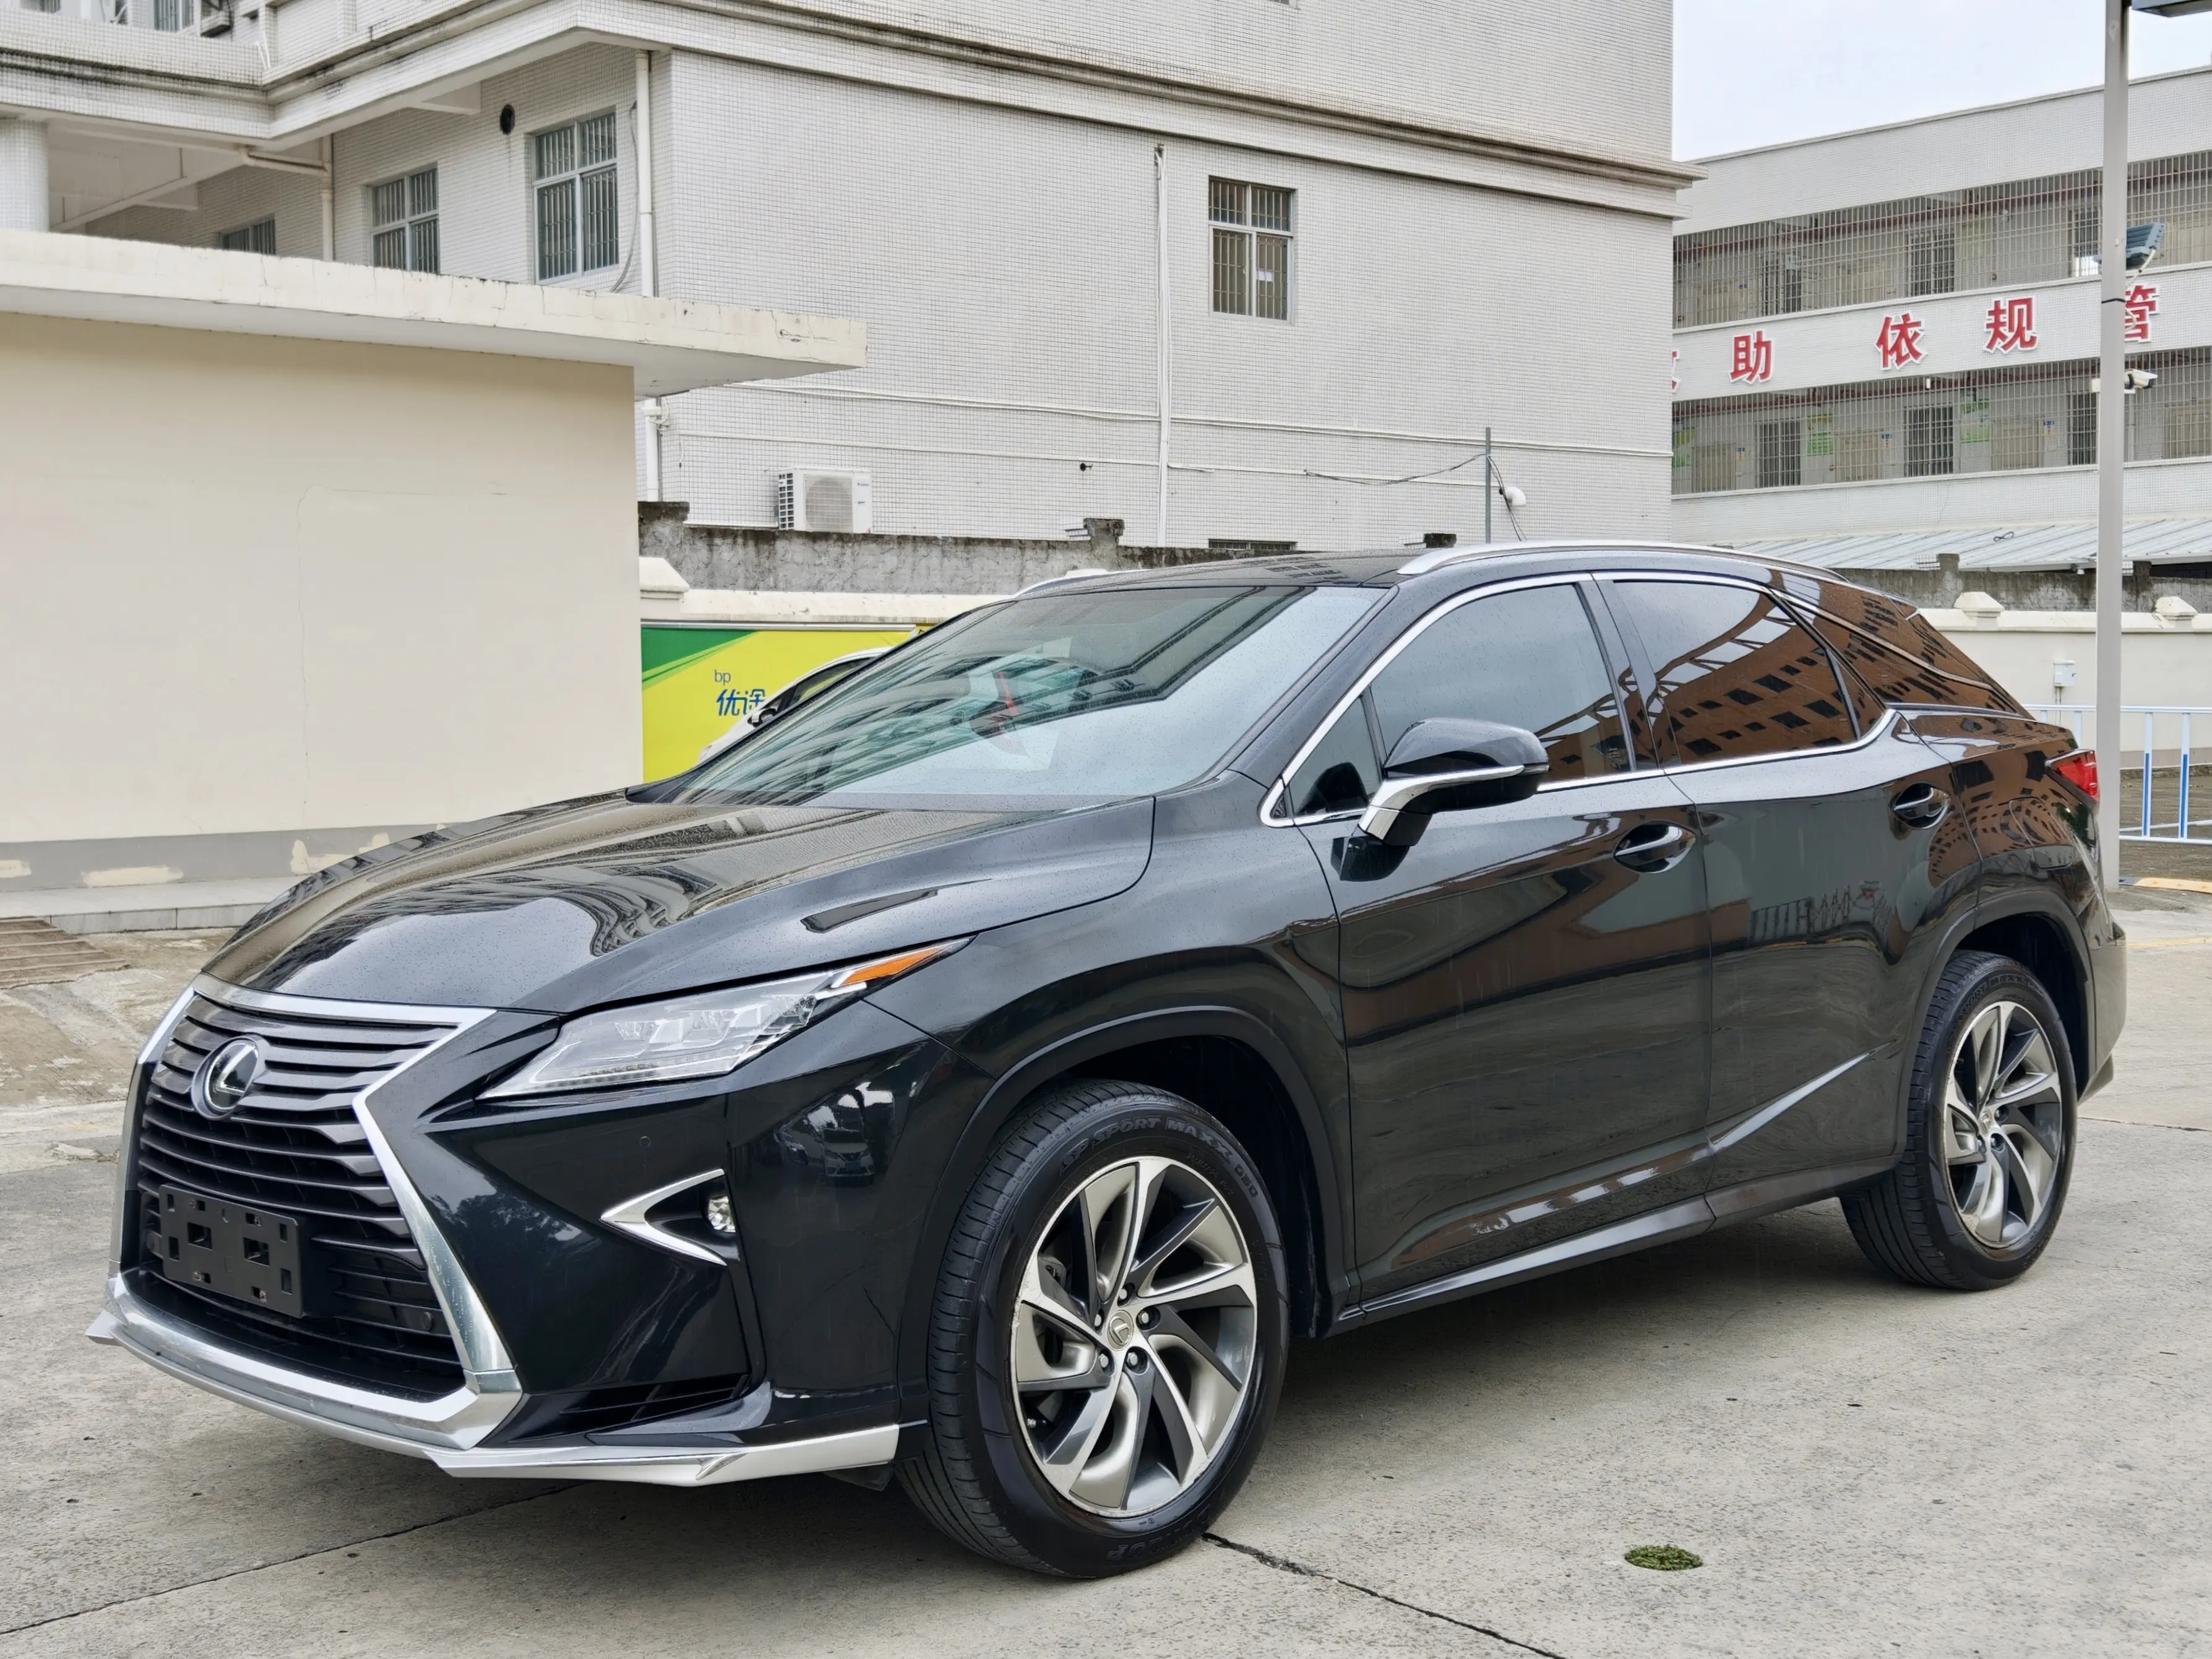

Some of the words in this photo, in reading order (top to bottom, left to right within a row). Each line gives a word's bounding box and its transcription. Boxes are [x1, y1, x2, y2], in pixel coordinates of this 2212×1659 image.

[715, 669, 731, 686] bp
[1093, 1116, 1161, 1148] SPORT
[1166, 1117, 1233, 1163] MAXX
